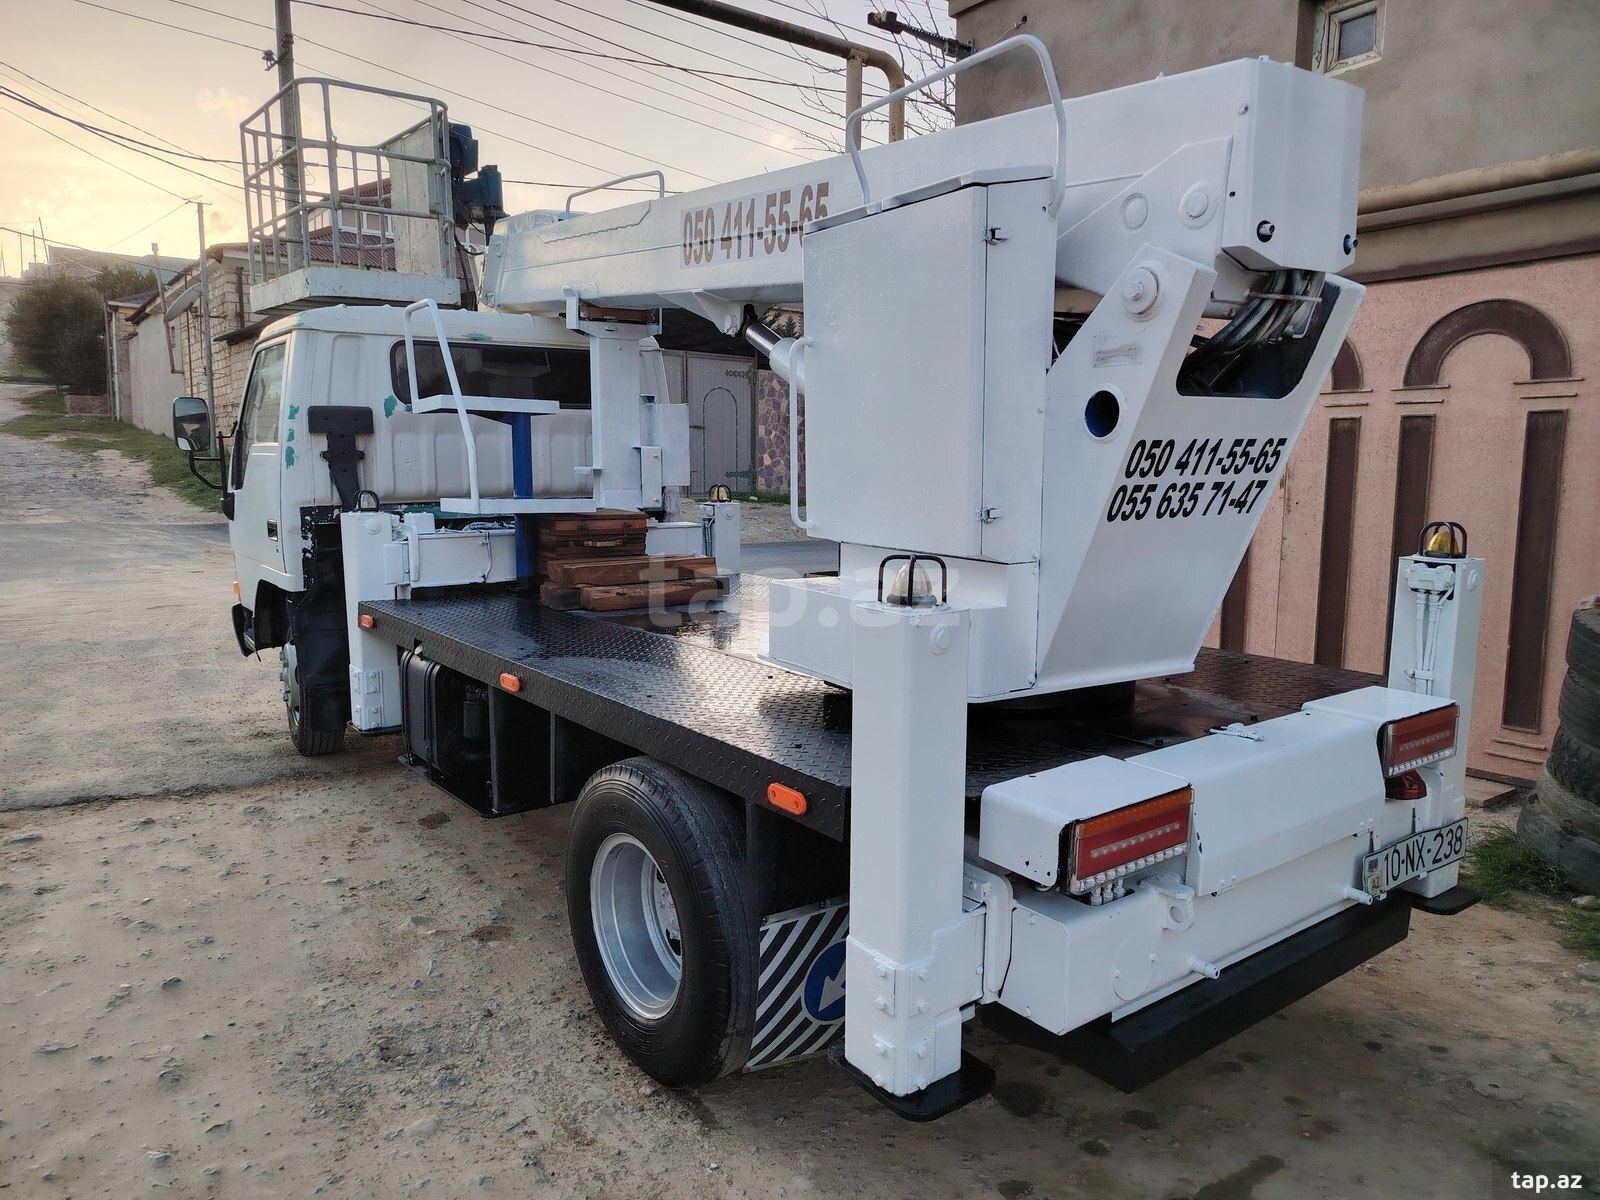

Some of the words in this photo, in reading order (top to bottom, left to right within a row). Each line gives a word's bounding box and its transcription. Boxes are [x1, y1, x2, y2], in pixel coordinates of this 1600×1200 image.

[683, 207, 715, 266] 050
[1125, 439, 1175, 478] 050
[1174, 438, 1288, 476] 411-55-65
[1106, 484, 1158, 522] 055
[1156, 482, 1205, 519] 635
[1202, 480, 1268, 516] 71-47
